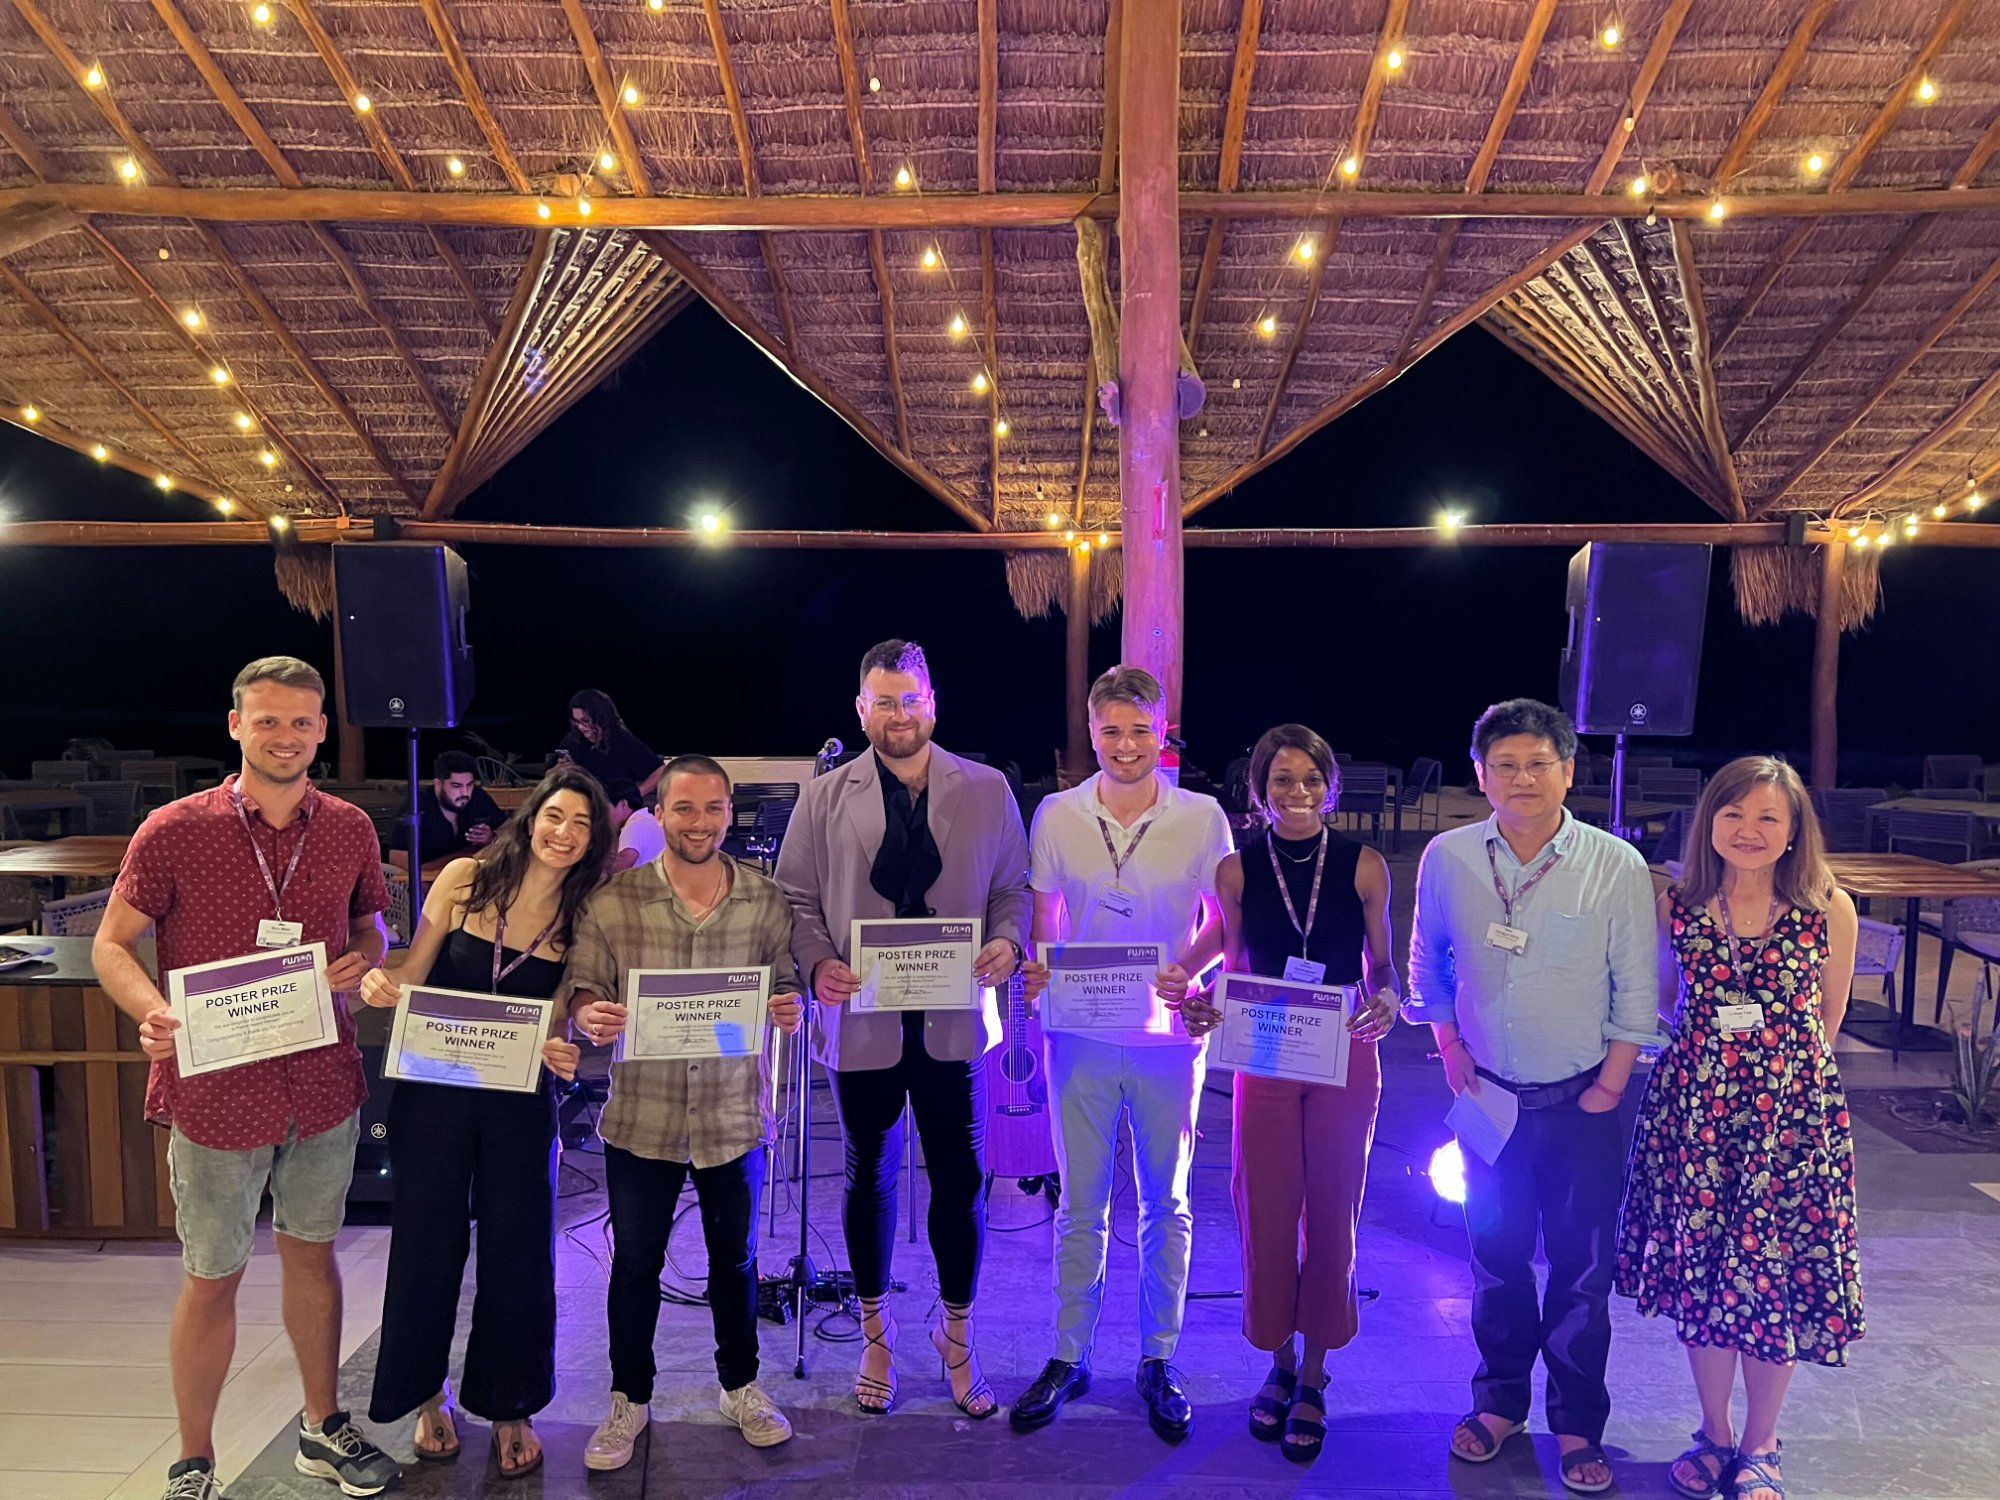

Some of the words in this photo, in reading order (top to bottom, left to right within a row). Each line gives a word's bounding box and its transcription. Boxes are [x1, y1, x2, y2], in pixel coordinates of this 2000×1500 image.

[878, 950, 922, 960] POSTER
[925, 950, 956, 959] PRIZE
[895, 962, 939, 972] WINNER
[1064, 973, 1109, 983] POSTER
[1111, 973, 1143, 982] PRIZE
[205, 990, 258, 1009] POSTER
[261, 982, 298, 998] PRIZE
[1082, 985, 1126, 995] WINNER
[227, 1000, 279, 1018] WINNER
[656, 1001, 704, 1010] POSTER
[707, 999, 741, 1009] PRIZE
[675, 1012, 722, 1022] WINNER
[1241, 1007, 1286, 1022] POSTER
[1289, 1014, 1322, 1027] PRIZE
[426, 1022, 478, 1036] POSTER
[481, 1028, 518, 1040] PRIZE
[1257, 1022, 1303, 1037] WINNER
[445, 1036, 496, 1050] WINNER
